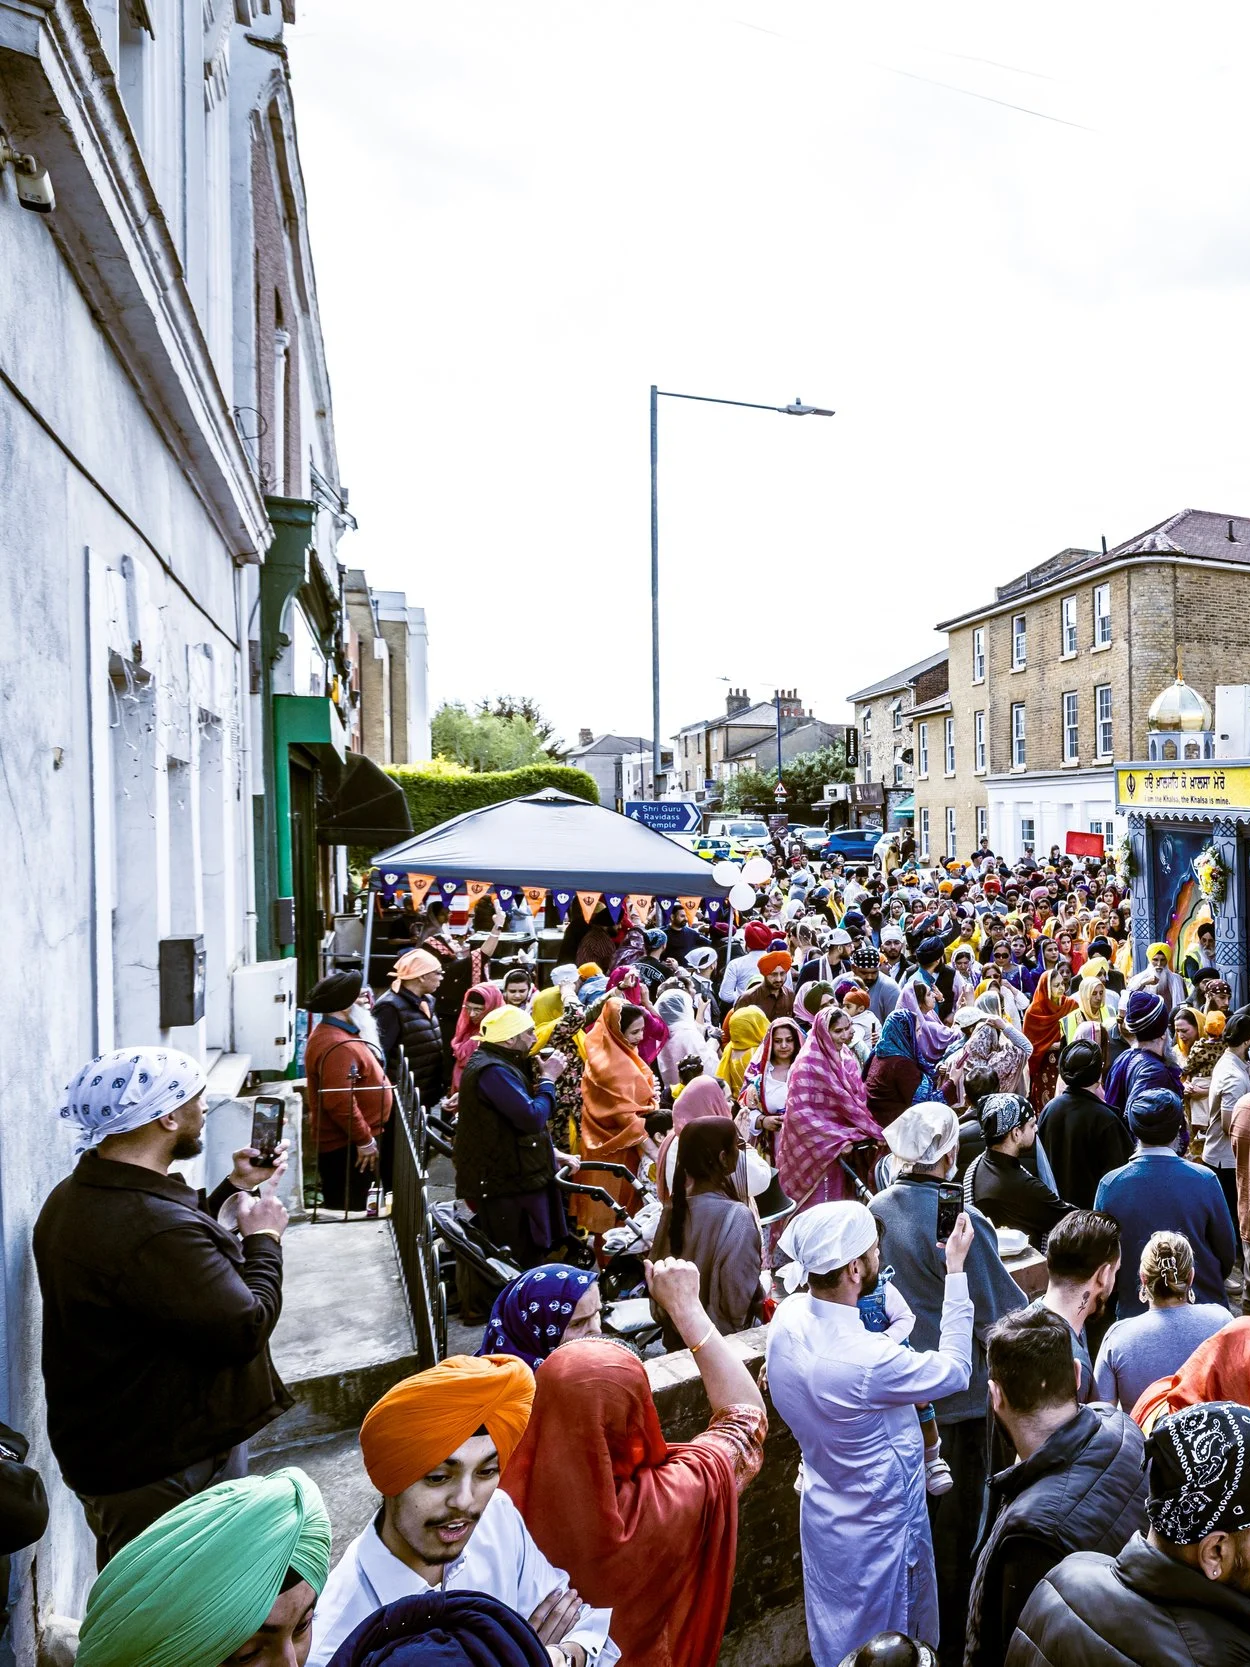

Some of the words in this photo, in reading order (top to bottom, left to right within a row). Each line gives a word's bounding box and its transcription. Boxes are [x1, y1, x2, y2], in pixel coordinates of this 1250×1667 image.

[1181, 796, 1190, 804] the
[1191, 796, 1208, 805] Khalsa
[647, 821, 677, 829] Temple
